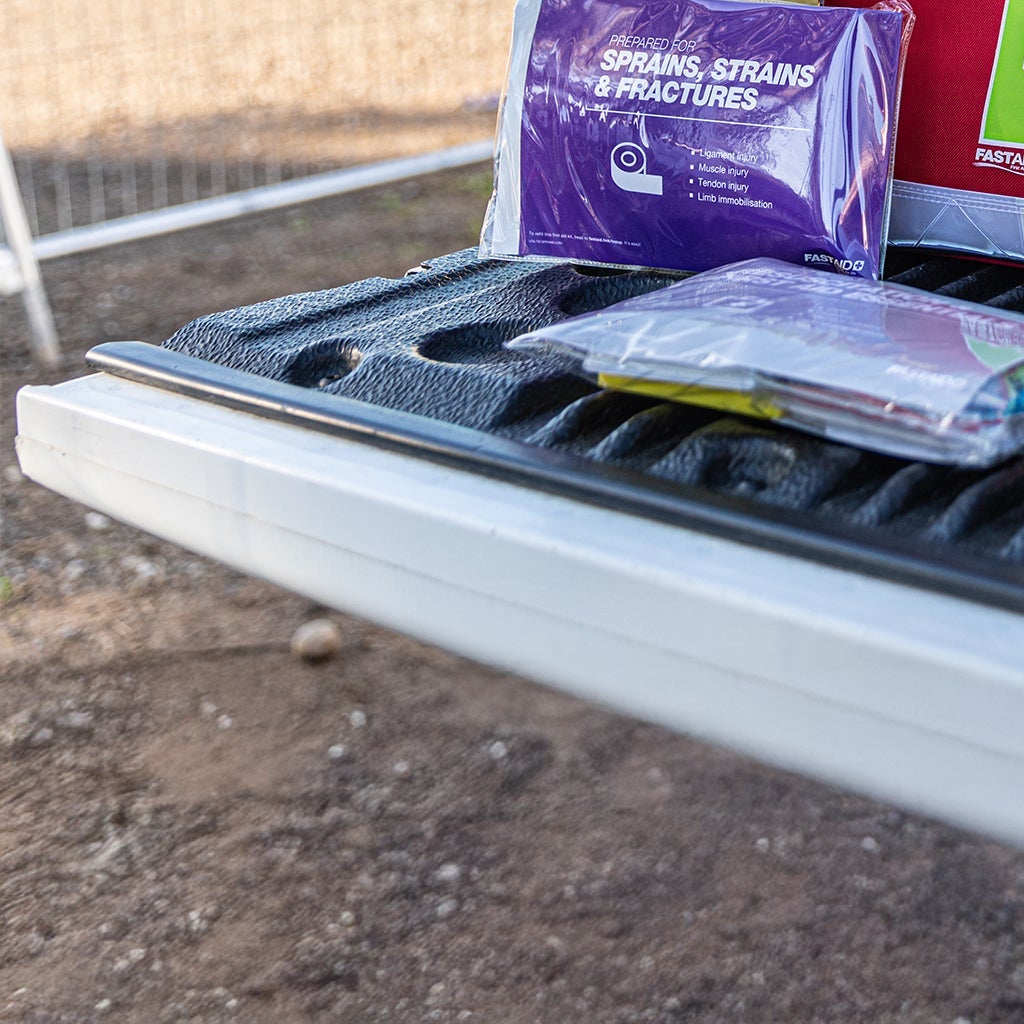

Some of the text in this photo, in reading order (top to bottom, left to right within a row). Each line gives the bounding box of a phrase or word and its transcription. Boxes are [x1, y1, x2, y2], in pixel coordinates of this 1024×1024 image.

[609, 34, 697, 52] PREPARED FOR
[600, 49, 816, 88] SPRAINS, STRAINS
[594, 75, 759, 111] & FRACTURES
[700, 148, 759, 165] Ligament injury
[698, 163, 750, 179] Muscle injury
[698, 177, 750, 194] Tendon injury
[697, 192, 773, 209] Limb immobilisation
